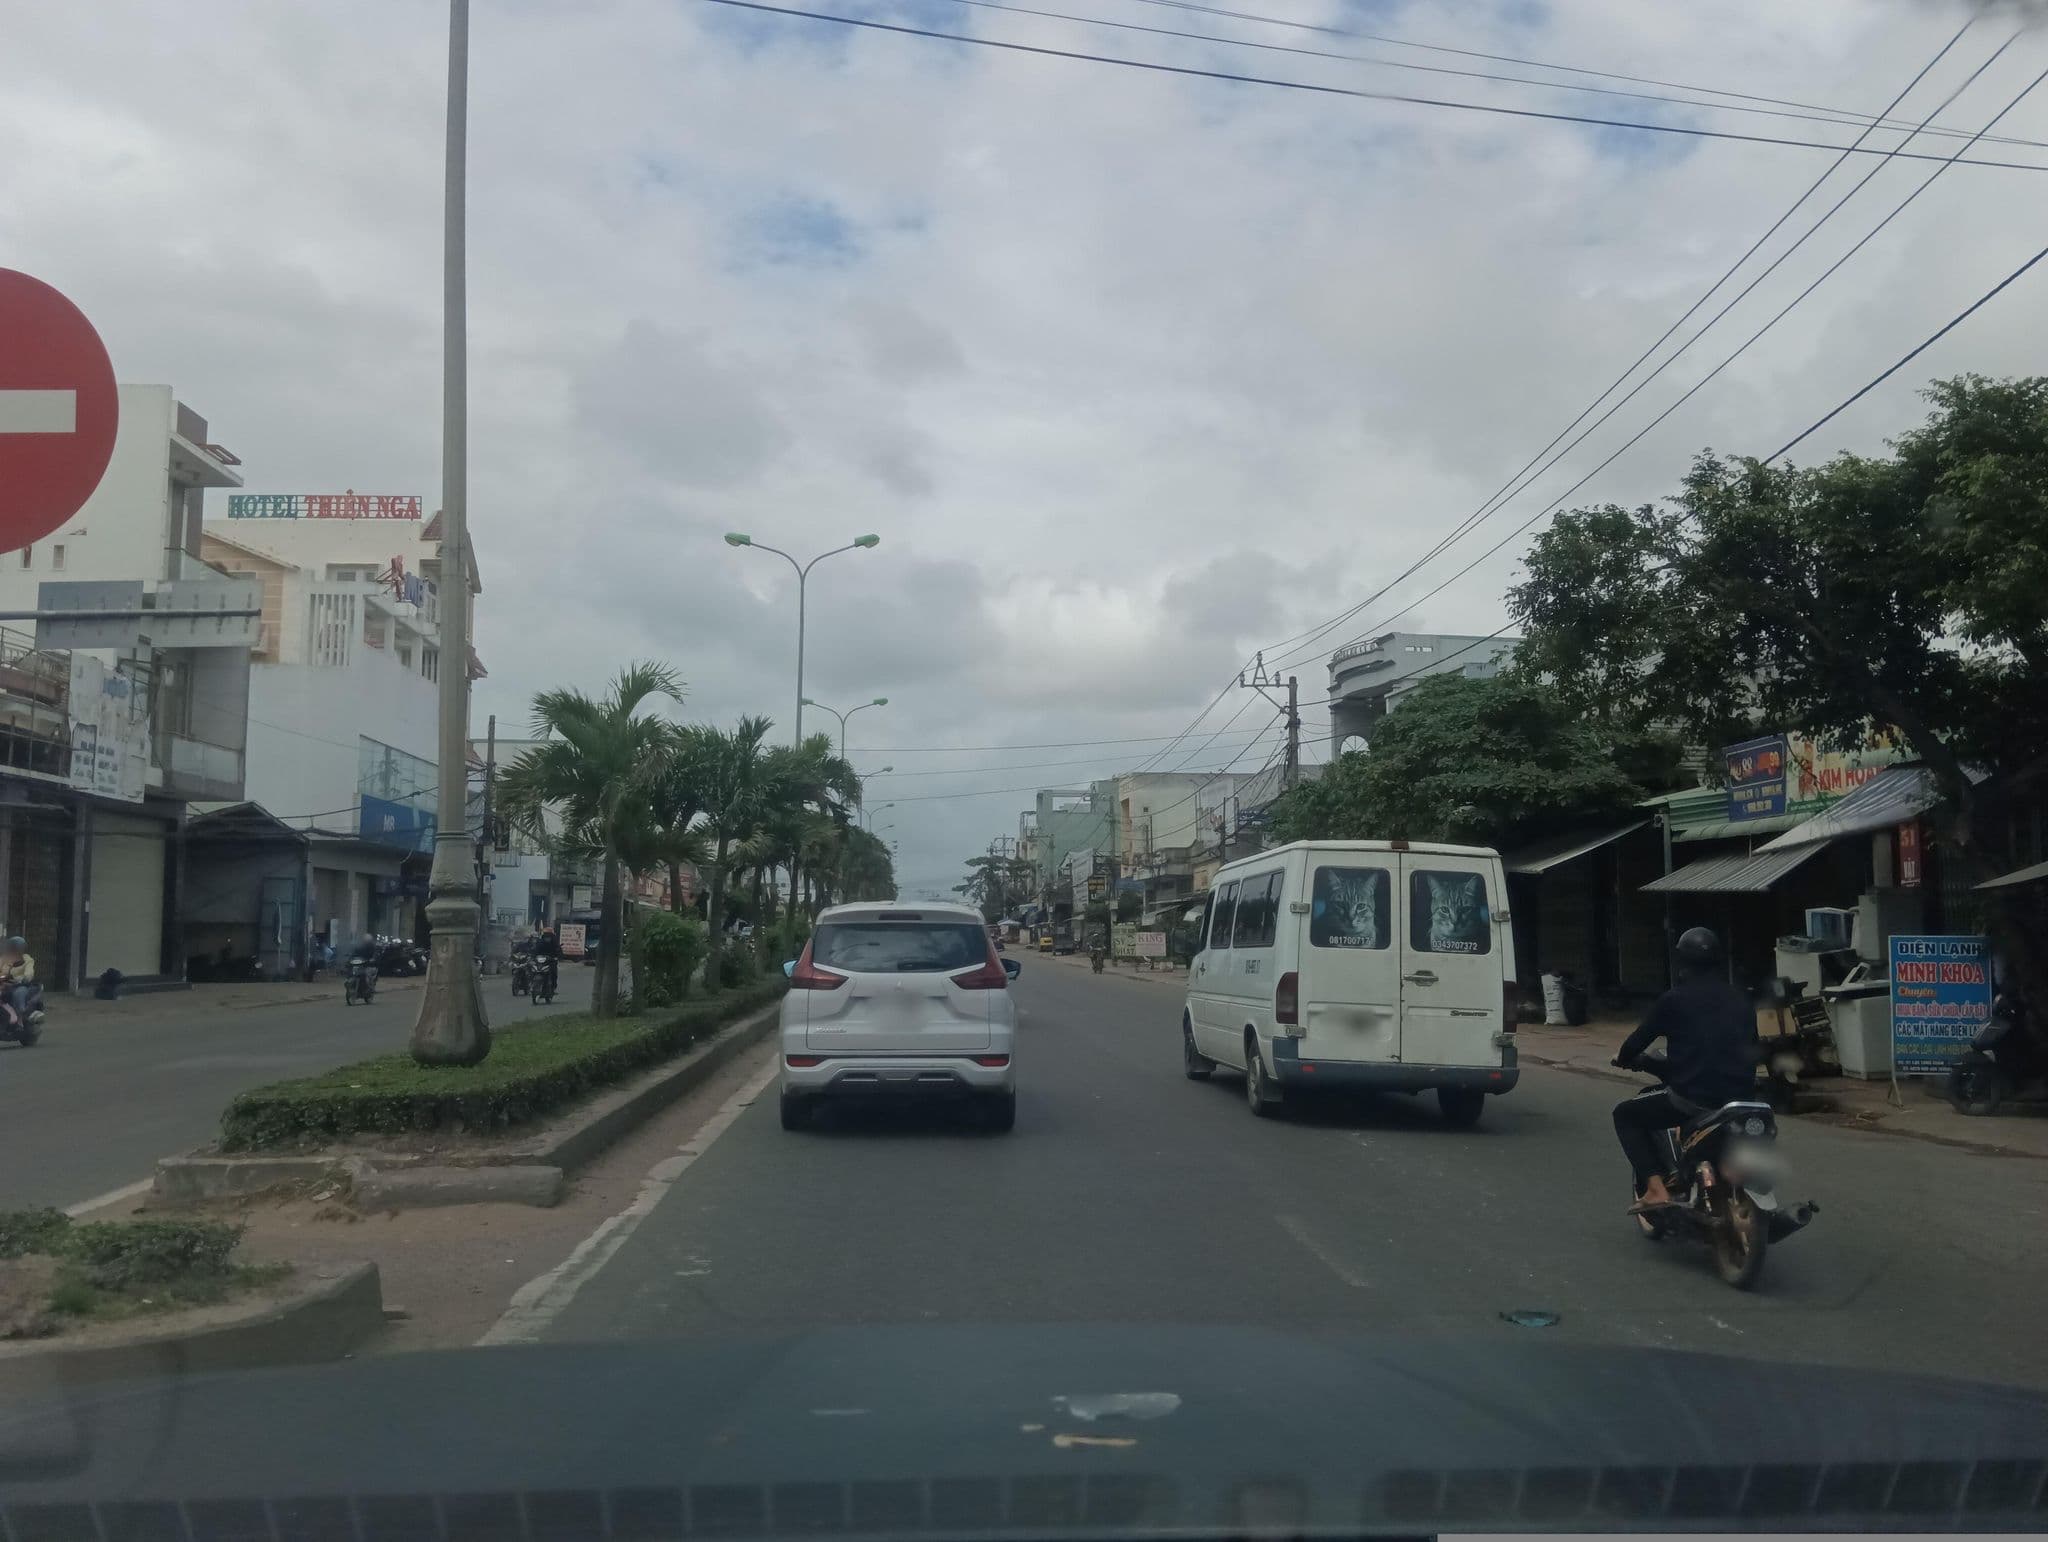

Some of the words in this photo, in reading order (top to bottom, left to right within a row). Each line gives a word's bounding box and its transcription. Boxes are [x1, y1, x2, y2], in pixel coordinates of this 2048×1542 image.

[228, 495, 298, 519] HOTEL
[375, 495, 422, 519] NGA
[1819, 767, 1842, 791] KIM
[1898, 940, 1937, 958] ĐIỆN
[1940, 942, 1983, 958] LẠNH
[1896, 961, 1937, 984] MINH
[1939, 962, 1985, 985] KHOA
[1896, 1020, 1912, 1038] CÁC
[1928, 1021, 1950, 1038] HÀNG
[1950, 1021, 1968, 1040] ĐIỆN
